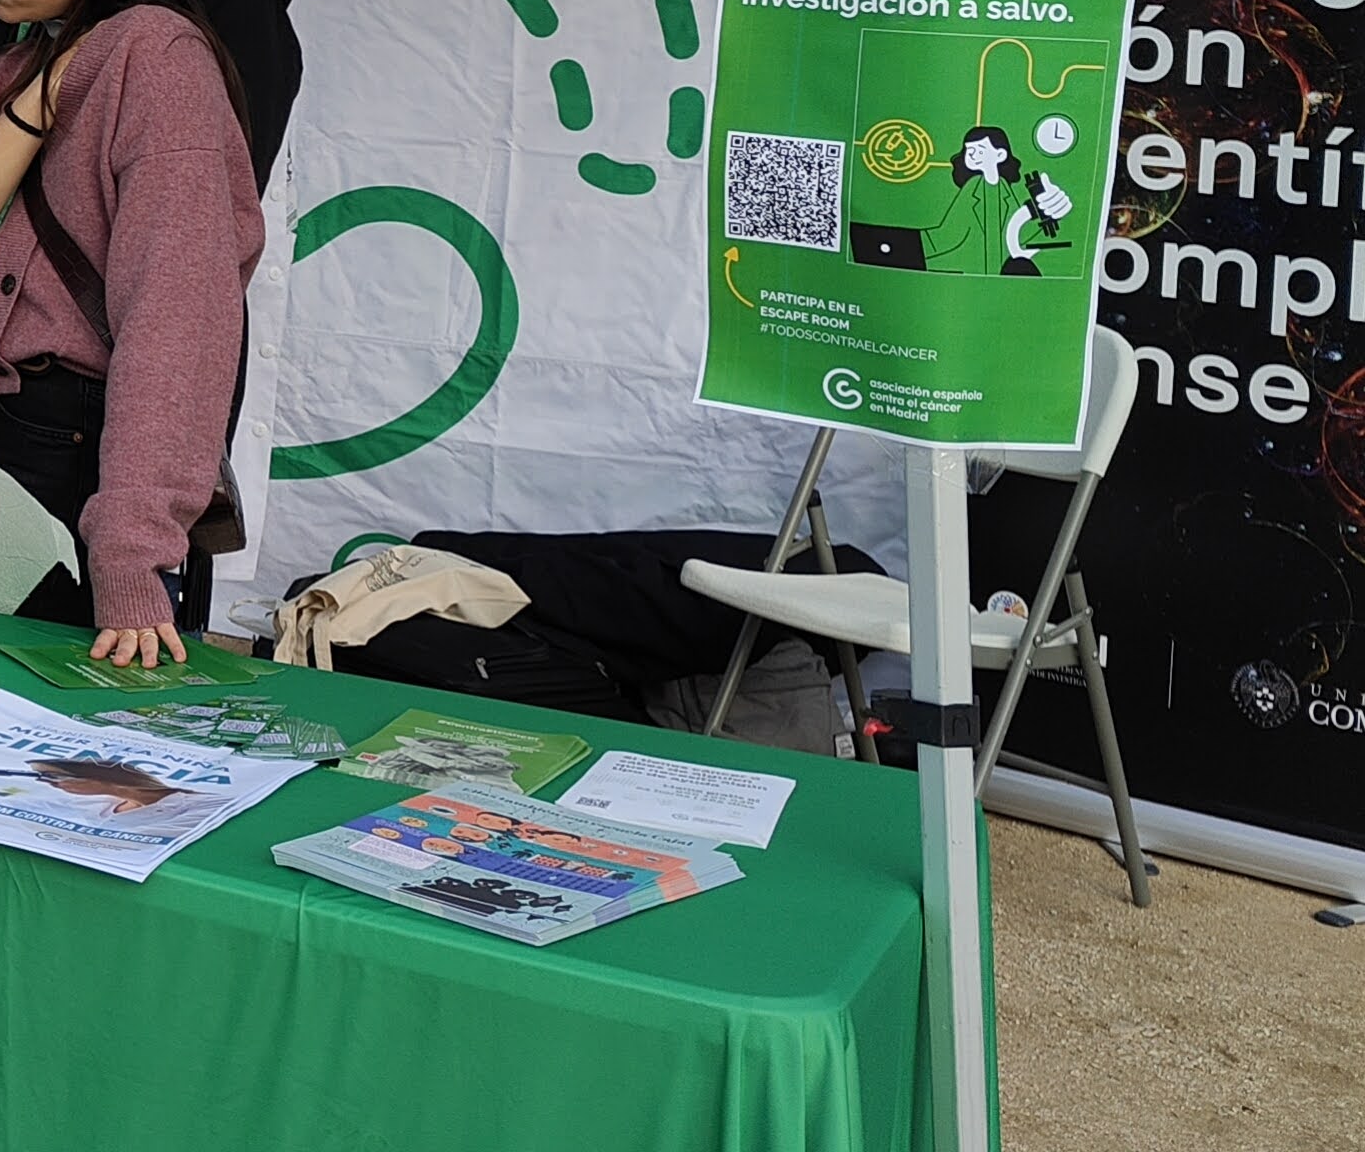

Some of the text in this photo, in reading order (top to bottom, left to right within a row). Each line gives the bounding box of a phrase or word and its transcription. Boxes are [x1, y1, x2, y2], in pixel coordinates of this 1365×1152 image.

[958, 1, 978, 18] a
[760, 290, 864, 317] PARTICIPA EN EL
[760, 306, 850, 331] ESCAPE ROOM
[760, 323, 938, 361] #TODOSCONTRAELCANCER
[869, 379, 983, 401] asociación española
[869, 392, 962, 413] contra el cáncer
[870, 404, 929, 422] en Madrid
[8, 725, 92, 748] MUJER
[160, 749, 232, 773] NIÑA
[13, 809, 75, 831] CONTRA
[77, 823, 97, 835] EL
